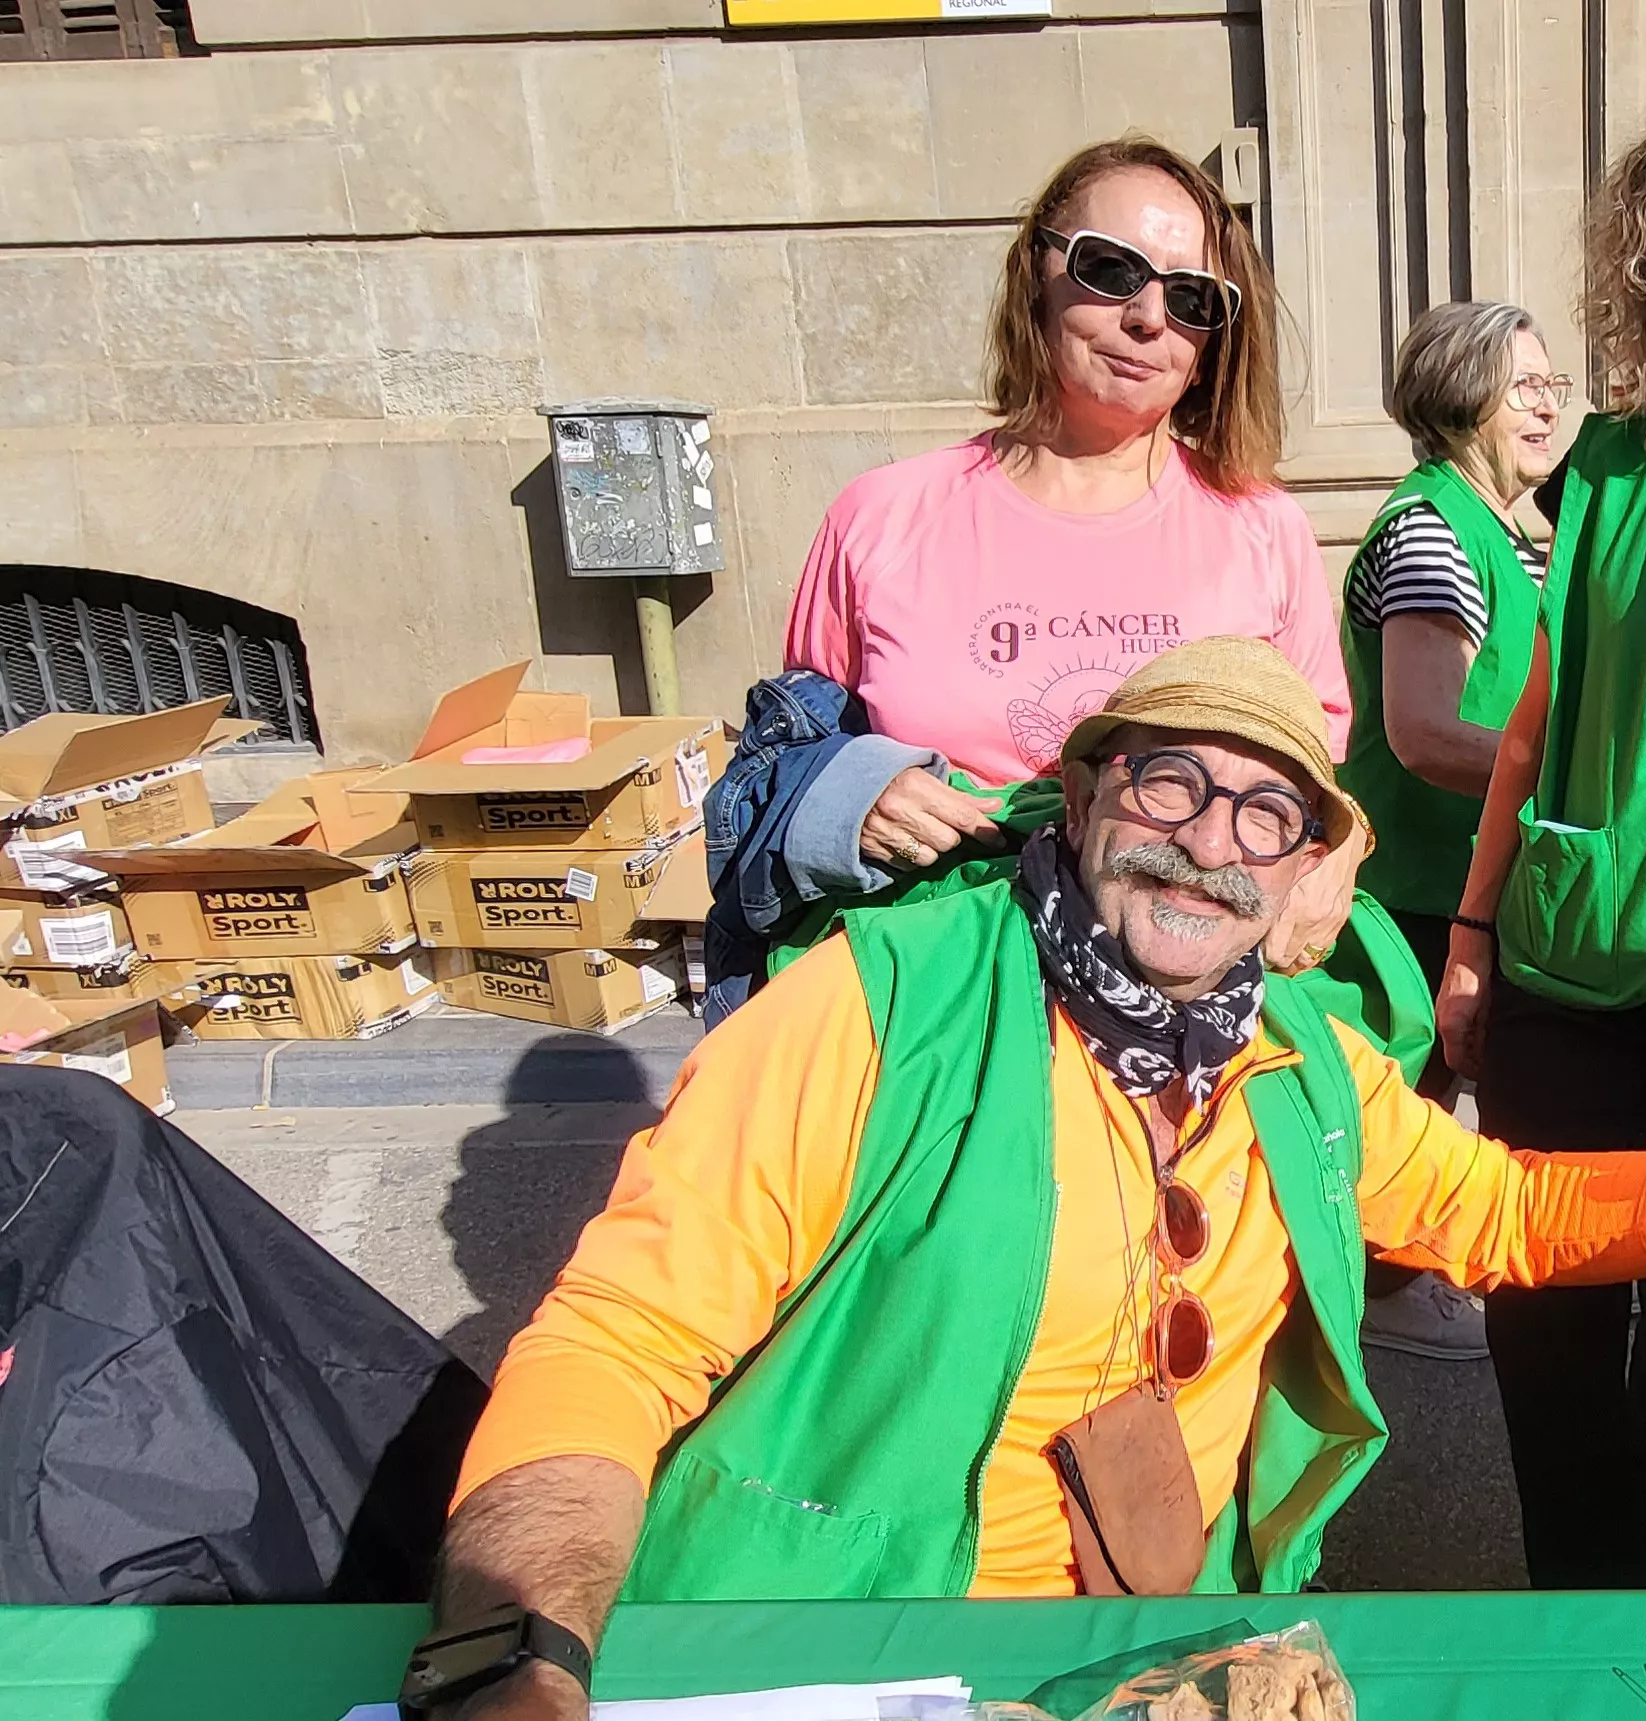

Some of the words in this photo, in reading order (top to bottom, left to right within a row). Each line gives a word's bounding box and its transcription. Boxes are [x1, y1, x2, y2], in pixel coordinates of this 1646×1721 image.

[974, 602, 1022, 630] CONTRA
[1026, 604, 1040, 617] EL
[1048, 610, 1181, 638] CÁNCER
[968, 632, 1004, 679] CARRERA
[228, 892, 300, 908] ROLY
[502, 882, 567, 899] ROLY
[491, 956, 543, 976] ROLY
